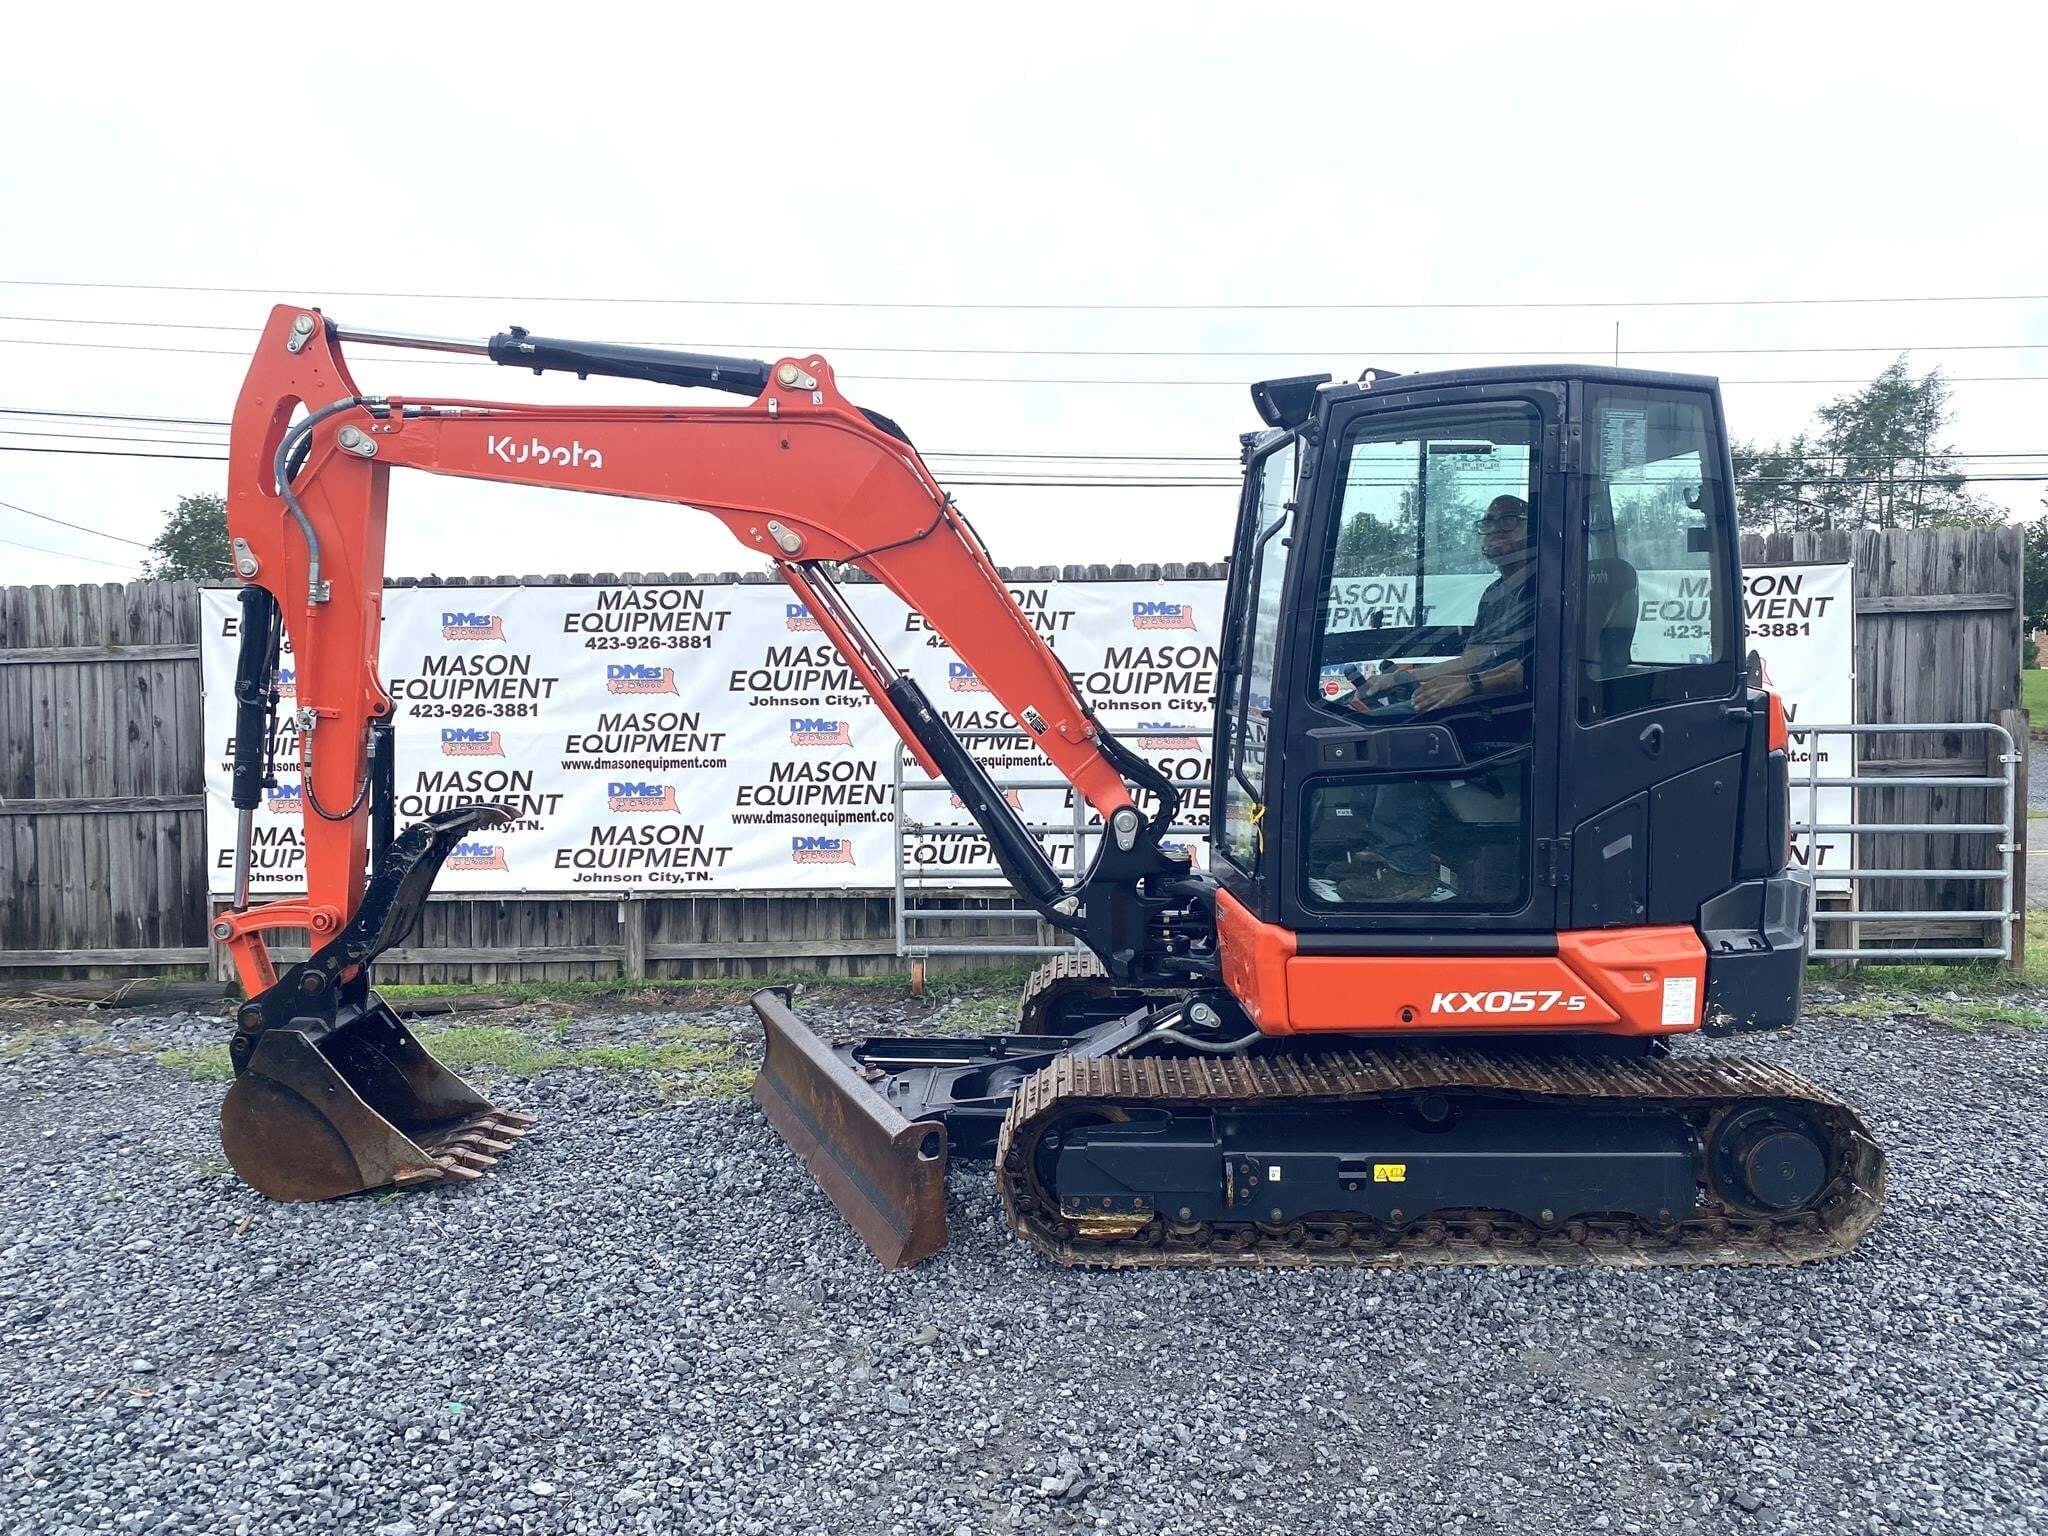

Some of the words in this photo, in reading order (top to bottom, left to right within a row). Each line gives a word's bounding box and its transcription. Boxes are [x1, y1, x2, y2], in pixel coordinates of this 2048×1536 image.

[488, 435, 603, 469] Kubota
[596, 589, 705, 611] MASON
[1328, 583, 1408, 605] ASON
[563, 611, 731, 633] EQUIPMENT
[585, 635, 713, 650] 423-926-3881
[421, 655, 531, 677] MASON
[389, 677, 559, 700] EQUIPMENT
[409, 703, 538, 718] 423-926-3881
[749, 695, 822, 707] Johnson
[597, 712, 700, 732] MASON
[565, 733, 726, 754] EQUIPMENT
[561, 757, 727, 772] www.dmasonequipment.com
[769, 761, 877, 783] MASON
[416, 770, 533, 793] MASON
[736, 783, 895, 807] EQUIPMENT
[732, 810, 894, 827] www.dmasonequipment.co
[590, 825, 704, 846] MASON
[554, 847, 733, 869] EQUIPMENT
[249, 872, 304, 882] ohnson
[572, 871, 643, 884] Johnson
[648, 871, 714, 885] City,TN.
[1430, 990, 1587, 1014] KX057-5
